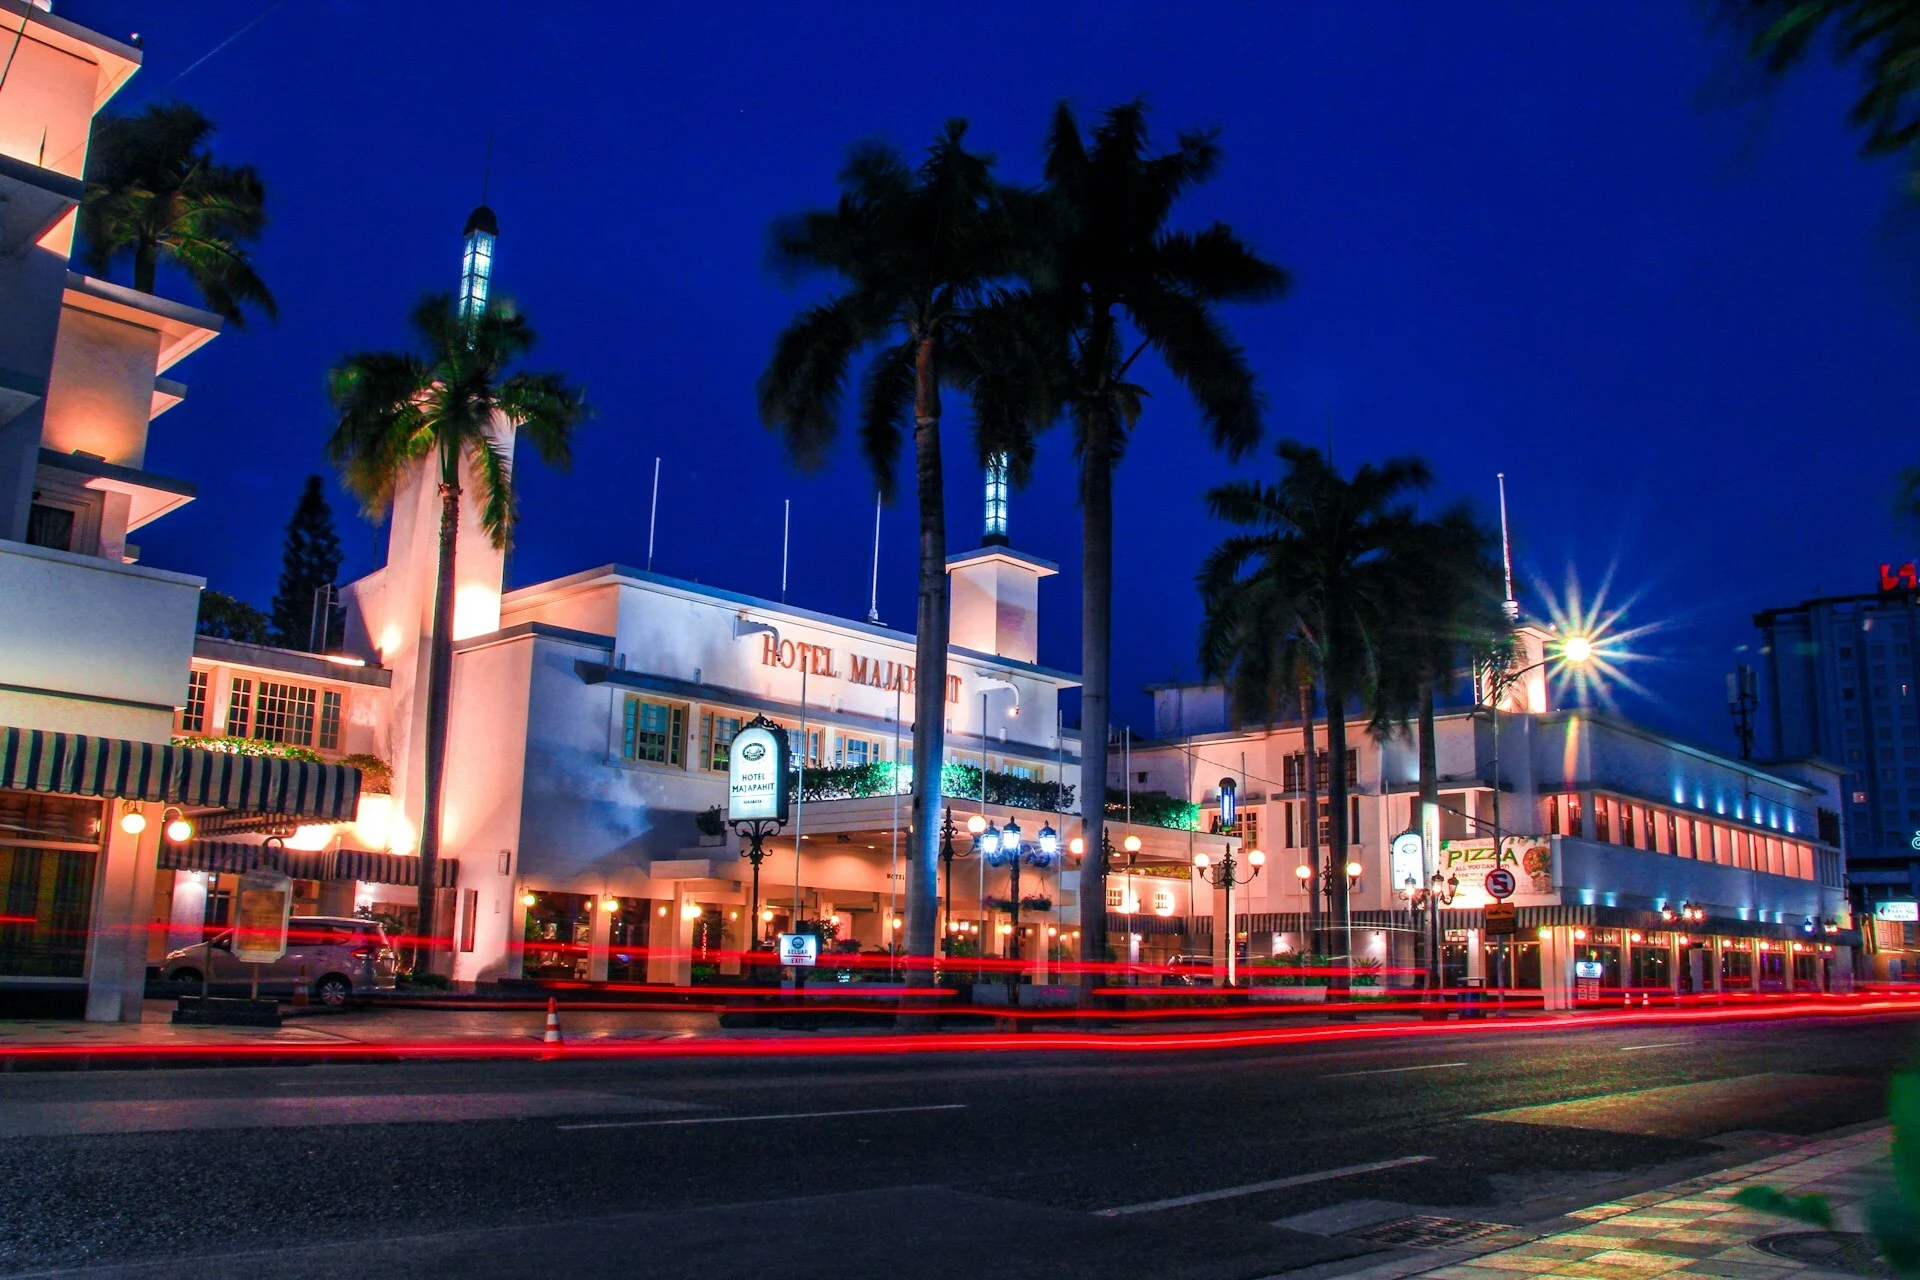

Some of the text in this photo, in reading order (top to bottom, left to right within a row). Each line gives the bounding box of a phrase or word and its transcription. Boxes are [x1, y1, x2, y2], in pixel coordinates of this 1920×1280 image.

[762, 633, 962, 704] HOTEL MAJAPIT
[742, 773, 765, 782] HOTEL
[732, 782, 775, 793] MAJAPAHIT
[1445, 847, 1520, 870] PIZZA
[1456, 863, 1467, 872] ALL
